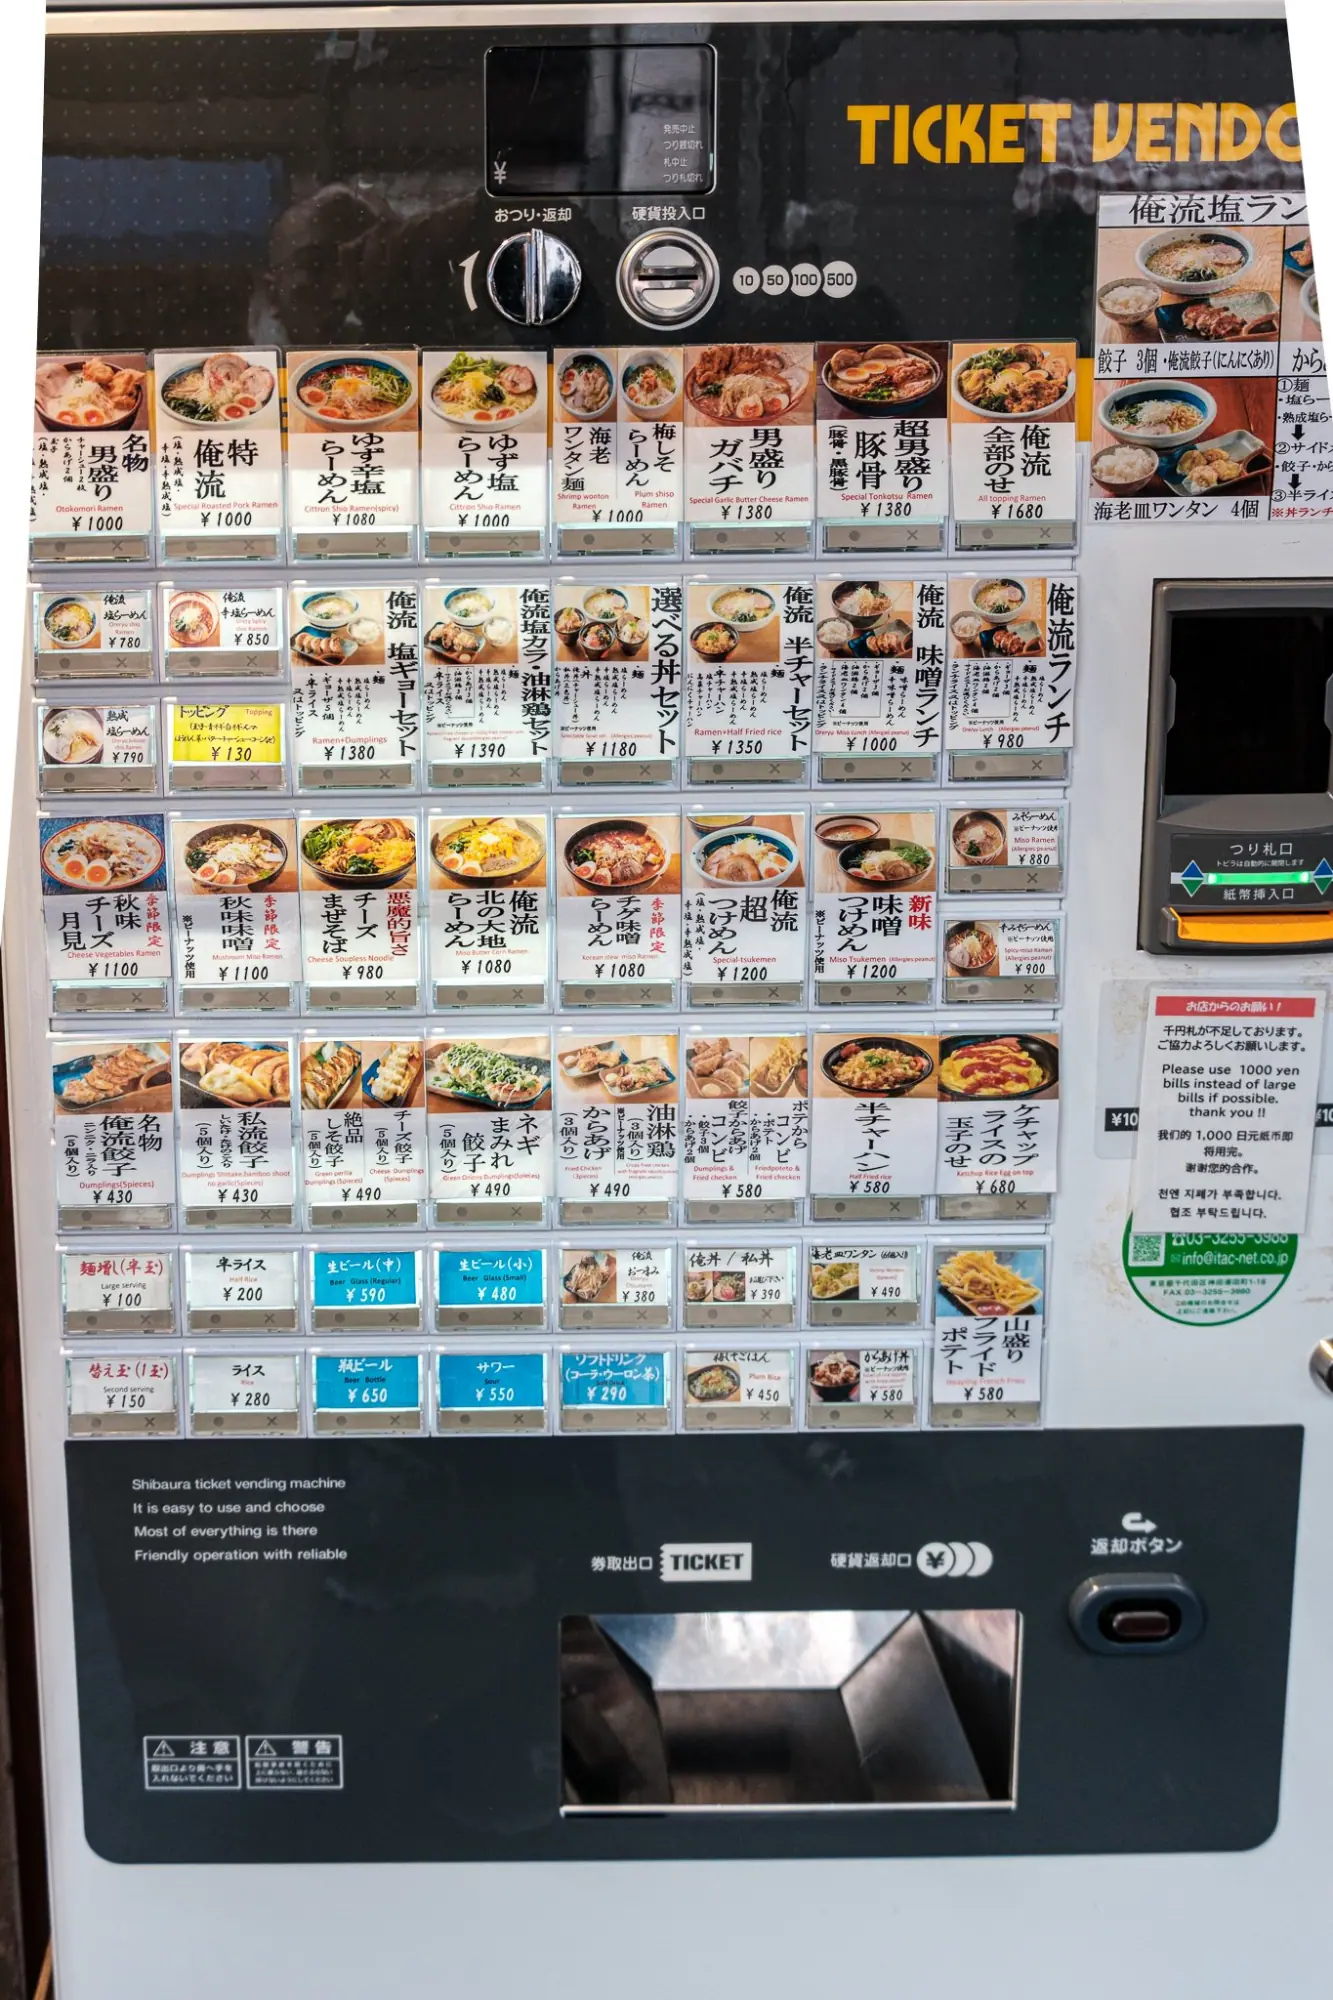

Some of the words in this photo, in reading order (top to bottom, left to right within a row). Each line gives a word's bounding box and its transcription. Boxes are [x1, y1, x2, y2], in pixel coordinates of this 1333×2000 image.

[663, 124, 696, 134] 発売中止
[846, 103, 1072, 165] TICKET
[663, 158, 688, 167] 札中止
[663, 173, 703, 183] つり札切れ
[495, 208, 572, 223] おつり・返却
[632, 206, 705, 221] 硬貨投入口
[739, 275, 754, 286] 10
[766, 273, 784, 286] 50
[794, 273, 818, 286] 100
[827, 272, 853, 286] 500
[1098, 349, 1127, 373] 餃子
[121, 434, 148, 473] 名物
[350, 433, 386, 495] ゆず辛塩
[487, 434, 520, 492] ゆず塩
[561, 426, 585, 491] ワンタン麺
[652, 423, 677, 472] 梅しそ
[855, 431, 887, 490] 豚骨
[894, 420, 931, 492] 超男盛り
[984, 425, 1015, 493] 全部のせ
[1020, 425, 1052, 477] 俺流
[88, 445, 119, 501] 男盛り
[194, 439, 226, 499] 俺流
[318, 440, 347, 504] らーめん
[842, 493, 867, 501] Special
[1095, 502, 1218, 521] 海老皿ワンタン
[651, 587, 682, 754] 選べる丼セット
[1045, 583, 1075, 743] 俺流ランチ
[245, 708, 273, 716] Topping
[1230, 843, 1292, 856] つり札口
[113, 894, 142, 930] 秋味
[908, 895, 932, 930] 新味
[1223, 888, 1294, 900] 紙幣挿入口
[59, 912, 86, 951] 月見
[85, 896, 115, 949] チーズ
[219, 896, 254, 951] 秋味味噌
[321, 894, 347, 953] まぜそば
[476, 890, 507, 949] 北の大地
[616, 896, 641, 945] チゲ味噌
[708, 899, 737, 955] つけめん
[872, 895, 903, 937] 味噌
[1158, 1041, 1305, 1052] ご協力よろしくお願いします。
[1163, 1026, 1303, 1037] 千円札が不足しております。
[1162, 1064, 1204, 1075] Please
[1209, 1066, 1231, 1075] use
[1240, 1065, 1272, 1075] 1000
[1276, 1067, 1299, 1076] yen
[1163, 1078, 1189, 1089] bills
[1194, 1079, 1241, 1089] instead
[1246, 1079, 1259, 1089] of
[1264, 1079, 1296, 1091] large
[1178, 1093, 1204, 1103] bills
[1209, 1093, 1218, 1103] if
[1222, 1093, 1278, 1105] possible.
[1189, 1107, 1226, 1117] thank
[1230, 1109, 1253, 1118] you
[99, 1116, 137, 1176] 俺流餃子
[237, 1112, 269, 1168] 私流餃子
[394, 1110, 413, 1164] チーズ餃子
[516, 1113, 540, 1155] ネギ
[583, 1107, 612, 1160] からあげ
[853, 1102, 891, 1172] 半チャーハン
[944, 1117, 974, 1168] 玉子のせ
[1012, 1104, 1041, 1166] ケチャップ
[1158, 1130, 1191, 1140] 我们的
[216, 1257, 266, 1272] 半ライス
[1183, 1251, 1288, 1266] info@itac-net.co.jp
[941, 1327, 968, 1375] ポテト
[971, 1317, 998, 1377] フライド
[1002, 1317, 1030, 1363] 山盛り
[232, 1364, 265, 1377] ライス
[476, 1362, 515, 1374] サワー
[132, 1479, 191, 1490] Shibaura
[195, 1479, 231, 1489] ticket
[235, 1478, 286, 1491] vending
[290, 1477, 346, 1489] machine
[133, 1503, 142, 1513] It
[147, 1503, 158, 1513] is
[162, 1504, 194, 1516] easy
[199, 1504, 212, 1513] to
[217, 1504, 241, 1513] use
[245, 1502, 271, 1513] and
[275, 1502, 325, 1513] choose
[134, 1526, 168, 1537] Most
[173, 1526, 186, 1537] of
[191, 1525, 262, 1538] everything
[267, 1525, 278, 1536] is
[282, 1525, 318, 1536] there
[1091, 1538, 1183, 1556] 返却ボタン
[134, 1550, 188, 1563] Friendly
[193, 1550, 258, 1562] operation
[263, 1549, 292, 1560] with
[298, 1549, 347, 1560] reliable
[670, 1553, 744, 1571] TICKET
[831, 1552, 911, 1569] 硬貨返却口
